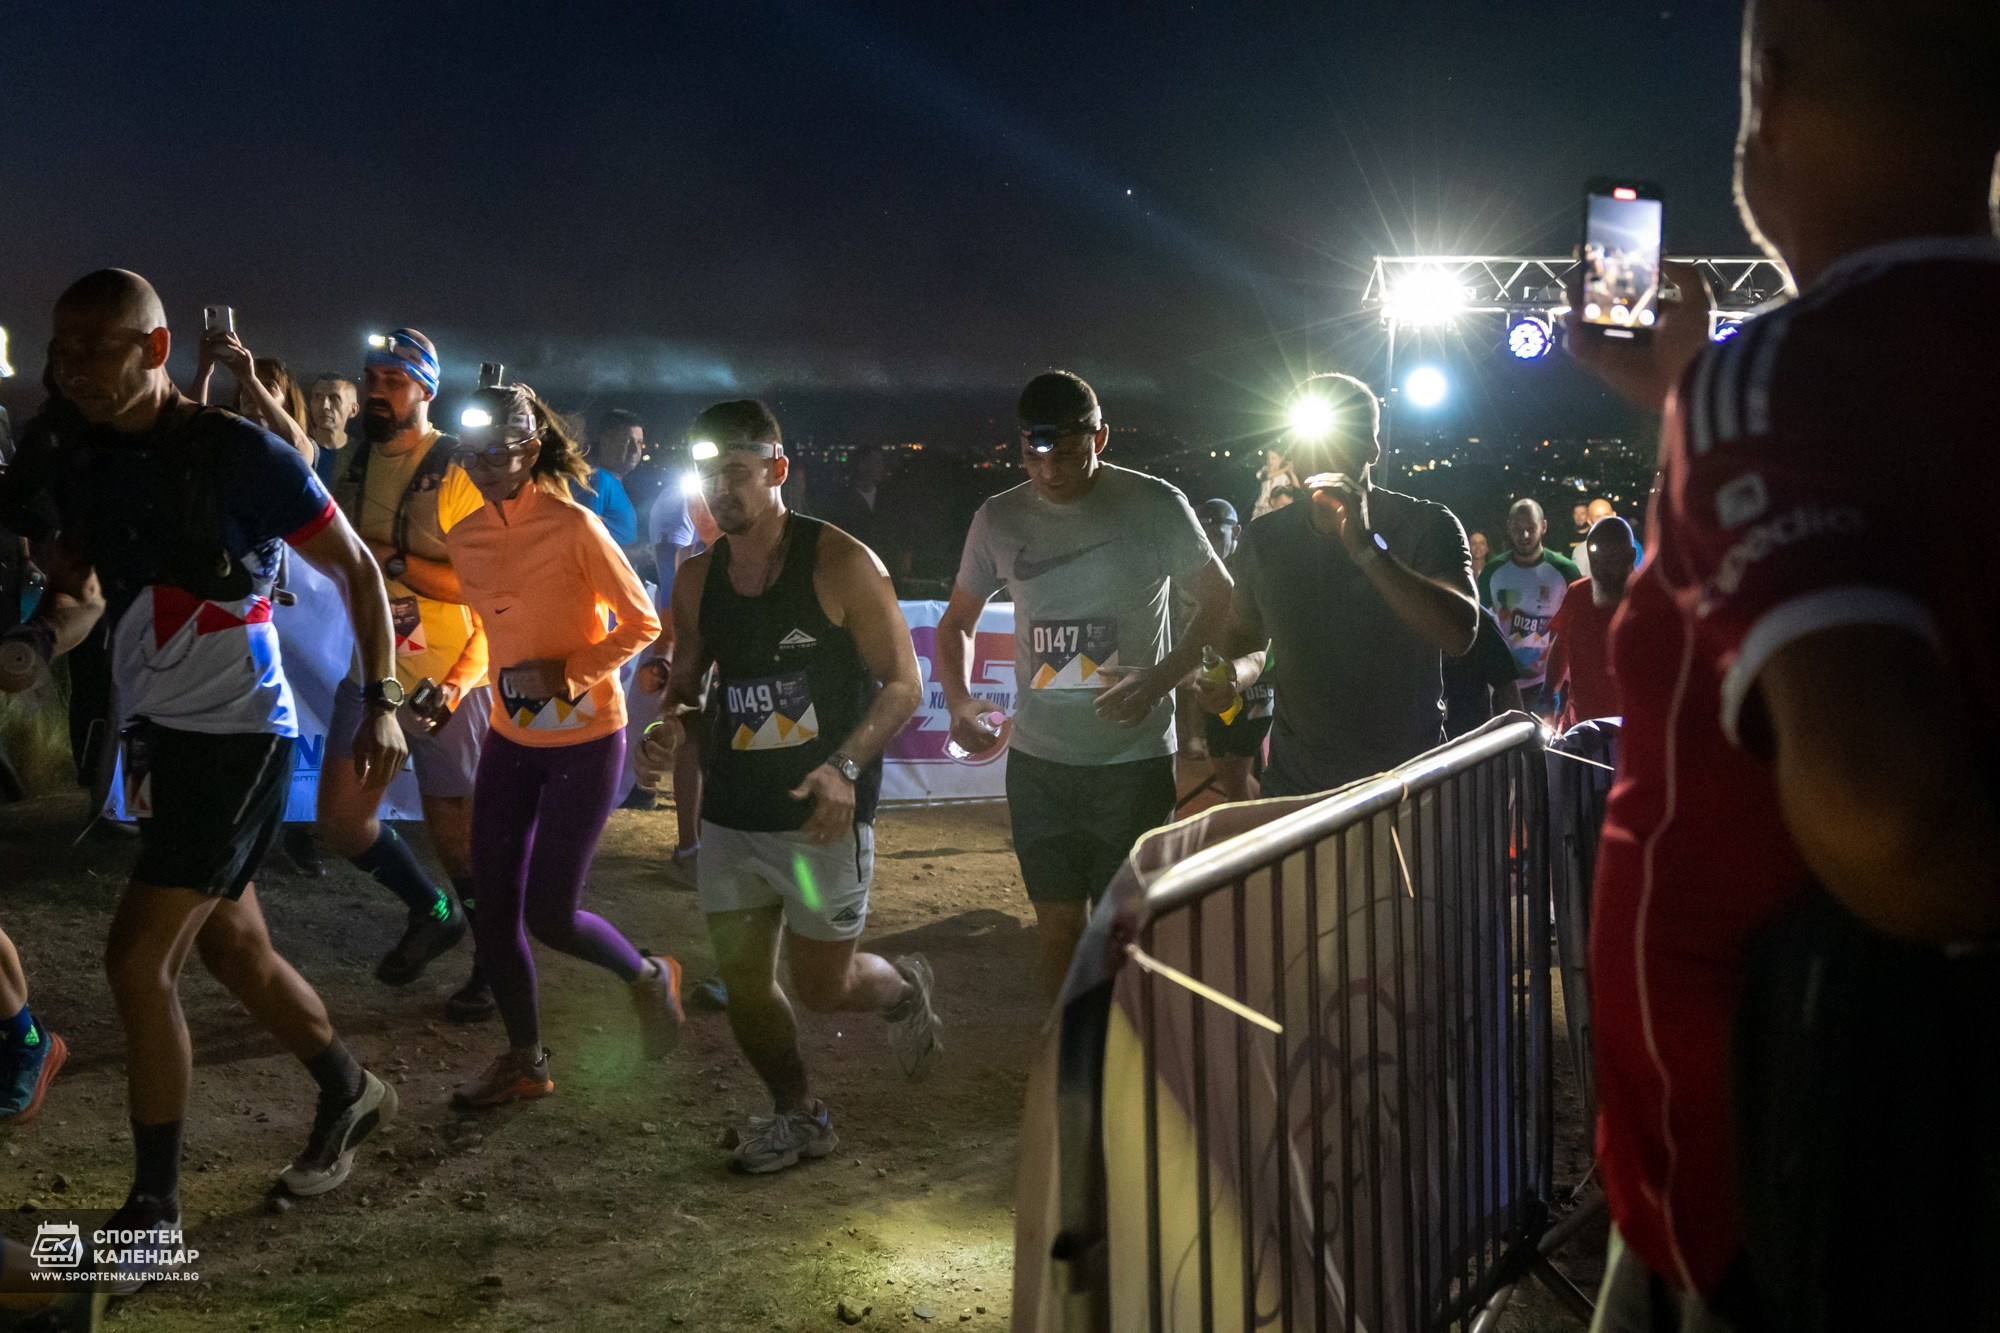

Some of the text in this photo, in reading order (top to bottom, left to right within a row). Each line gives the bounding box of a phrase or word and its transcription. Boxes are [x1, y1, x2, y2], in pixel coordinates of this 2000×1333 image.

[1513, 615, 1538, 631] 0128
[1033, 626, 1079, 653] 0147
[727, 684, 774, 713] 0149
